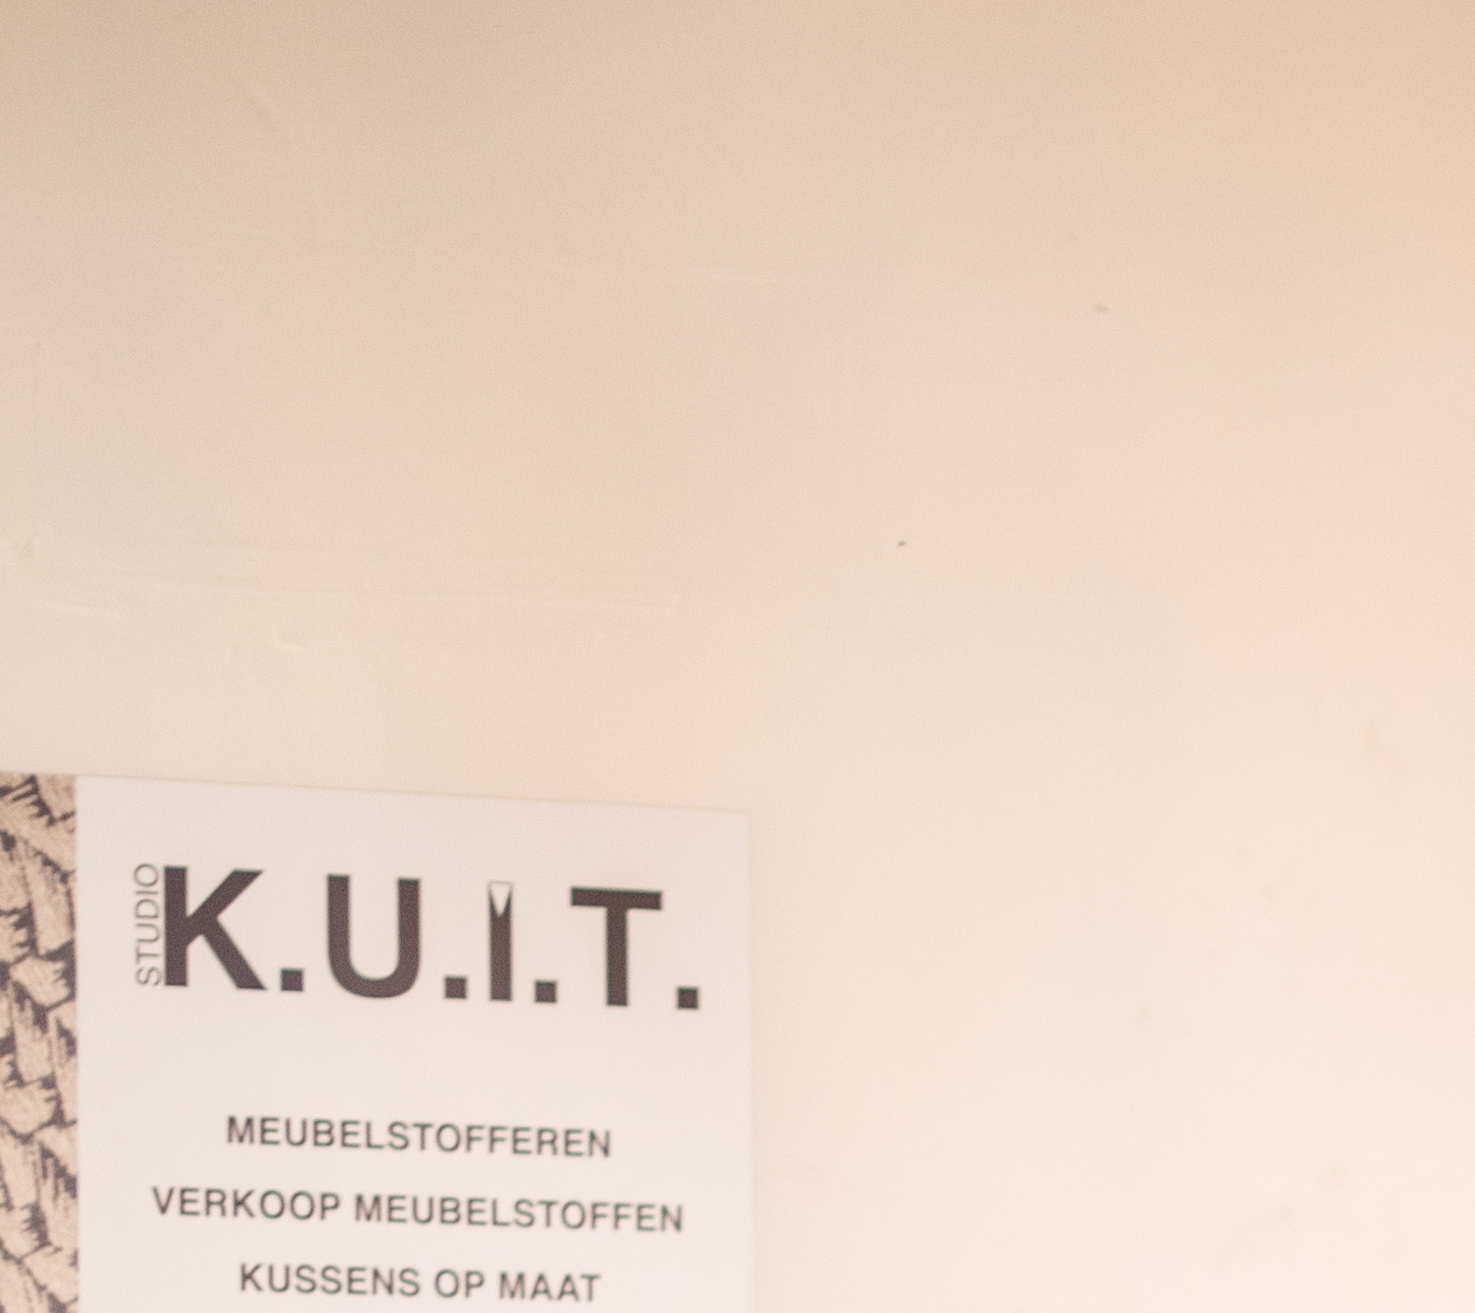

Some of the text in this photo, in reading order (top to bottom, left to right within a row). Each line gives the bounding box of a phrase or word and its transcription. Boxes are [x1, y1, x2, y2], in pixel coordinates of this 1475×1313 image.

[133, 862, 161, 988] STUDIO
[162, 864, 701, 1012] K.U.I.T.
[225, 1114, 612, 1159] MEUBELSTOFFEREN
[151, 1185, 684, 1234] VERKOOP MEUBELSTOFFEN
[239, 1262, 602, 1303] KUSSENS OP MAAT
